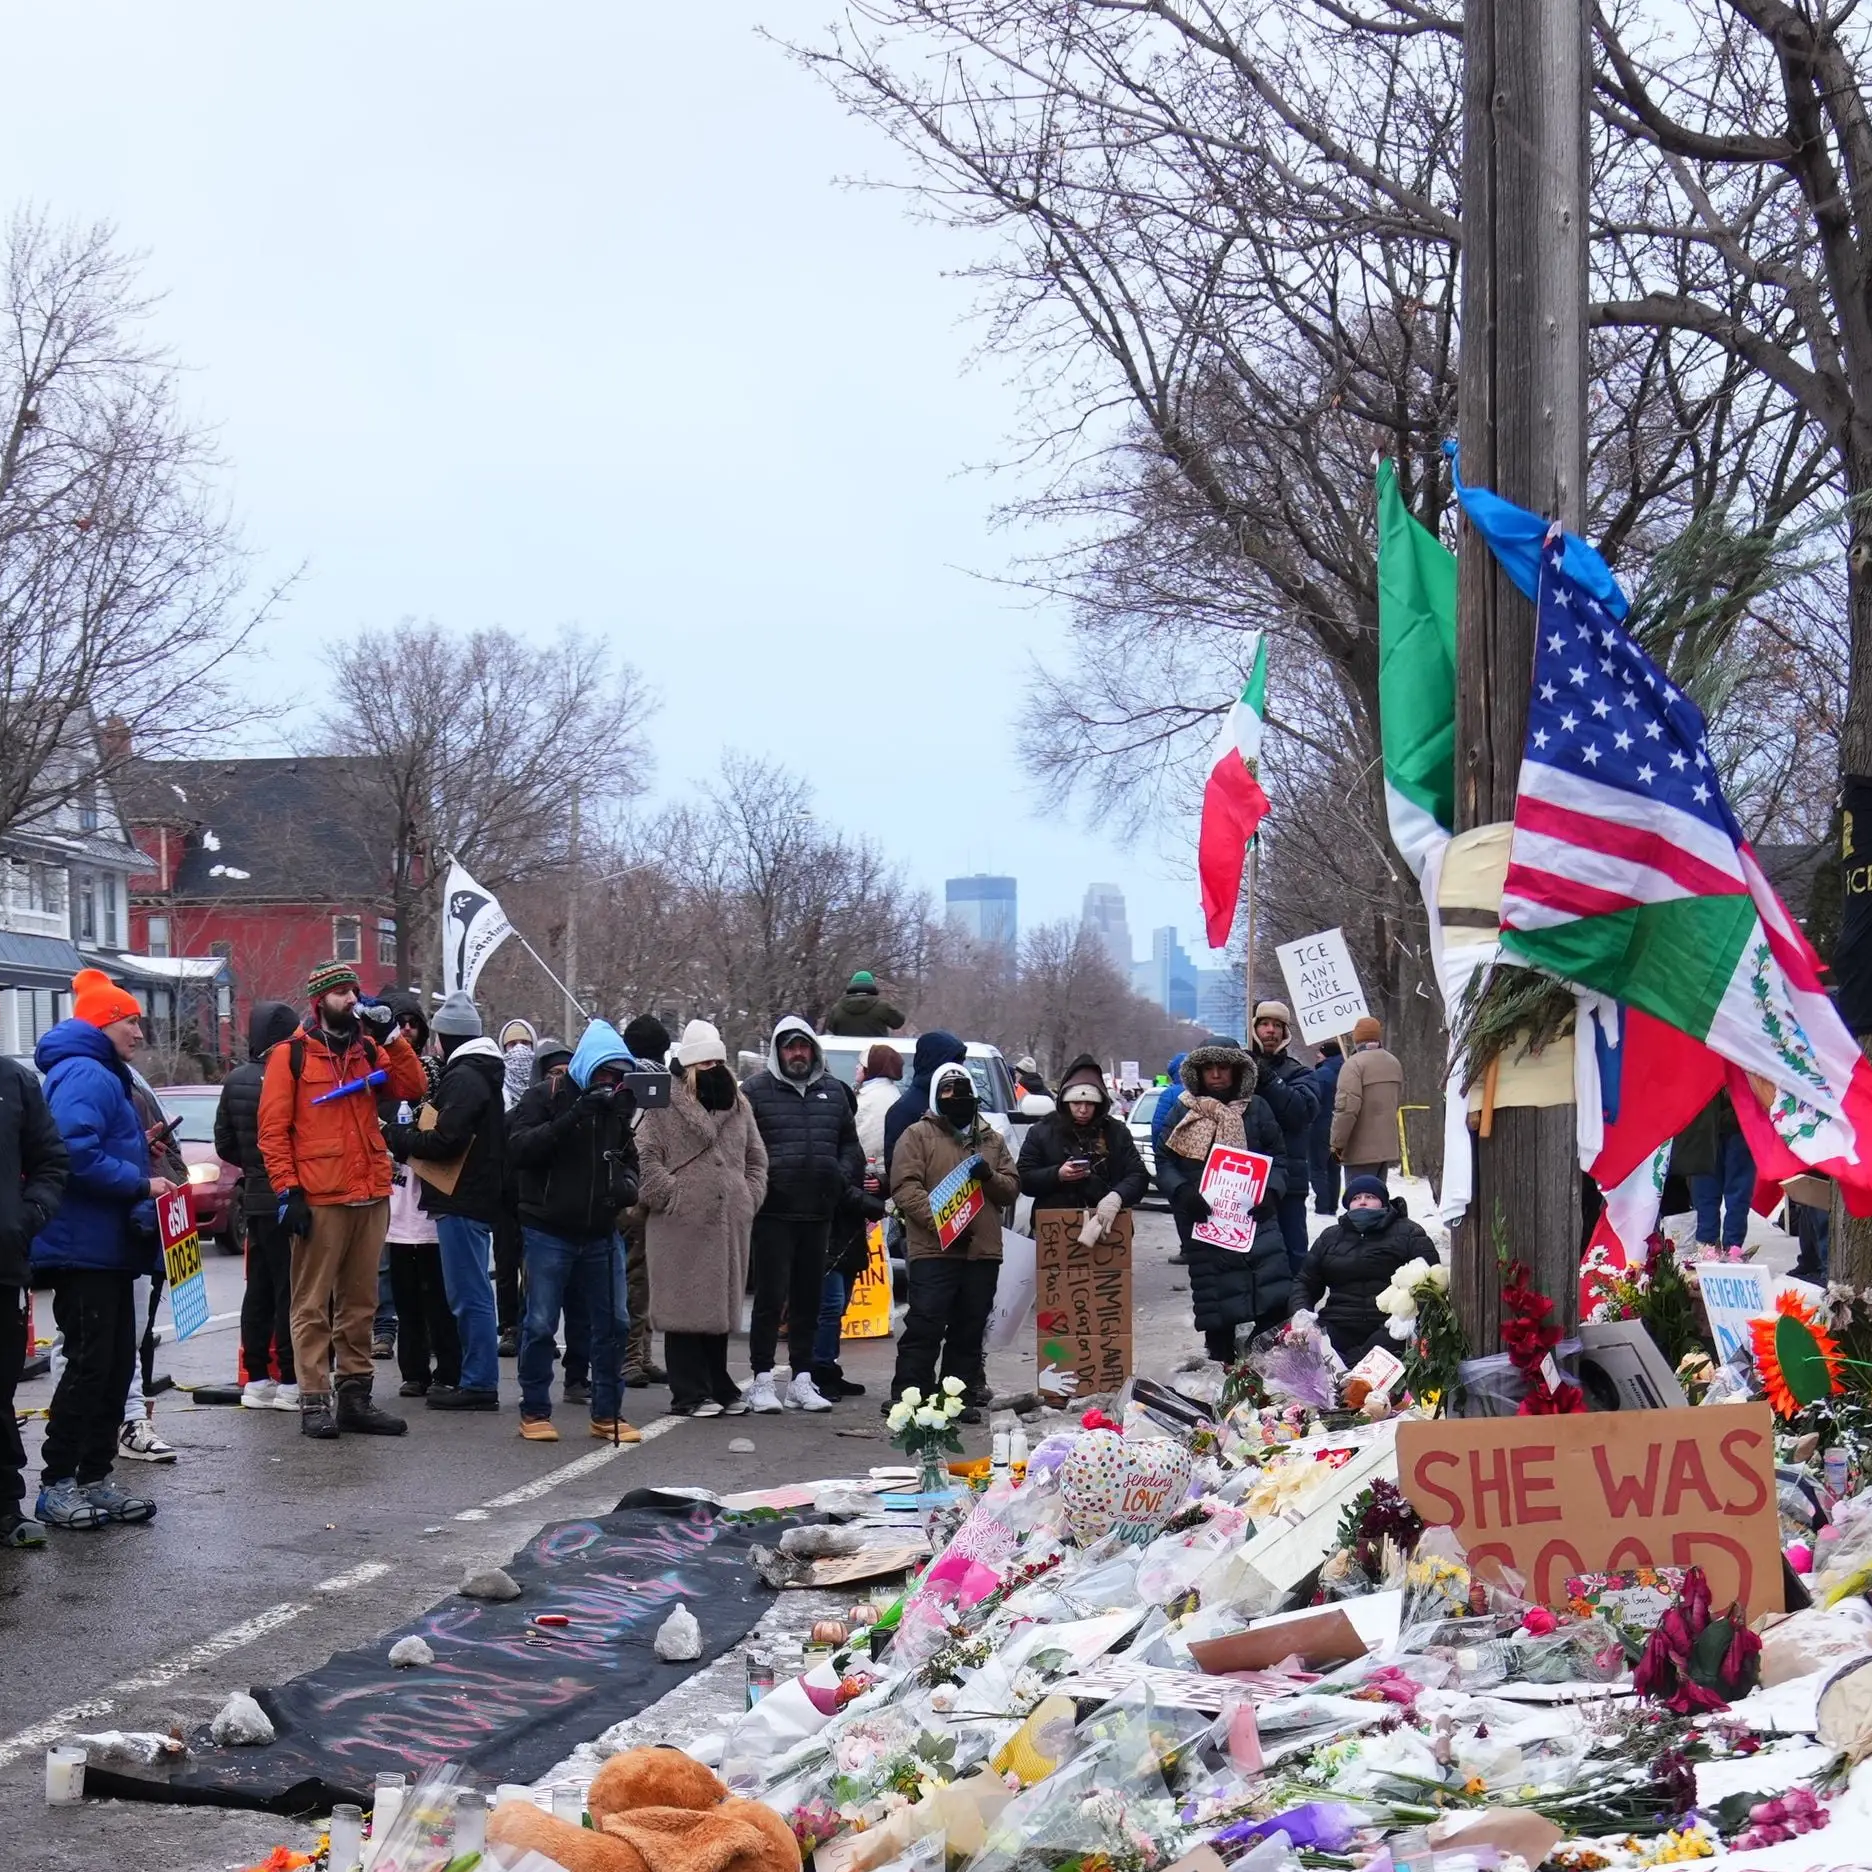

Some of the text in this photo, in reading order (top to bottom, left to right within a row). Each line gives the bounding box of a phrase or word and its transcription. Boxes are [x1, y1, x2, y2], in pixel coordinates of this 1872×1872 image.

[1294, 943, 1329, 966] ICE
[1300, 961, 1336, 987] AIN'T
[1308, 980, 1340, 1003] NICE
[1303, 1000, 1362, 1027] ICE OUT
[168, 1195, 190, 1238] MSP
[938, 1180, 977, 1227] ICE OUT
[1213, 1198, 1242, 1212] OUT OF
[950, 1201, 973, 1237] MSP
[167, 1243, 189, 1287] OUT
[1703, 1274, 1764, 1311] REMEMBER
[1123, 1471, 1174, 1496] sending
[1413, 1428, 1769, 1530] SHE WAS
[1121, 1486, 1165, 1514] LOVE
[1128, 1512, 1151, 1524] and
